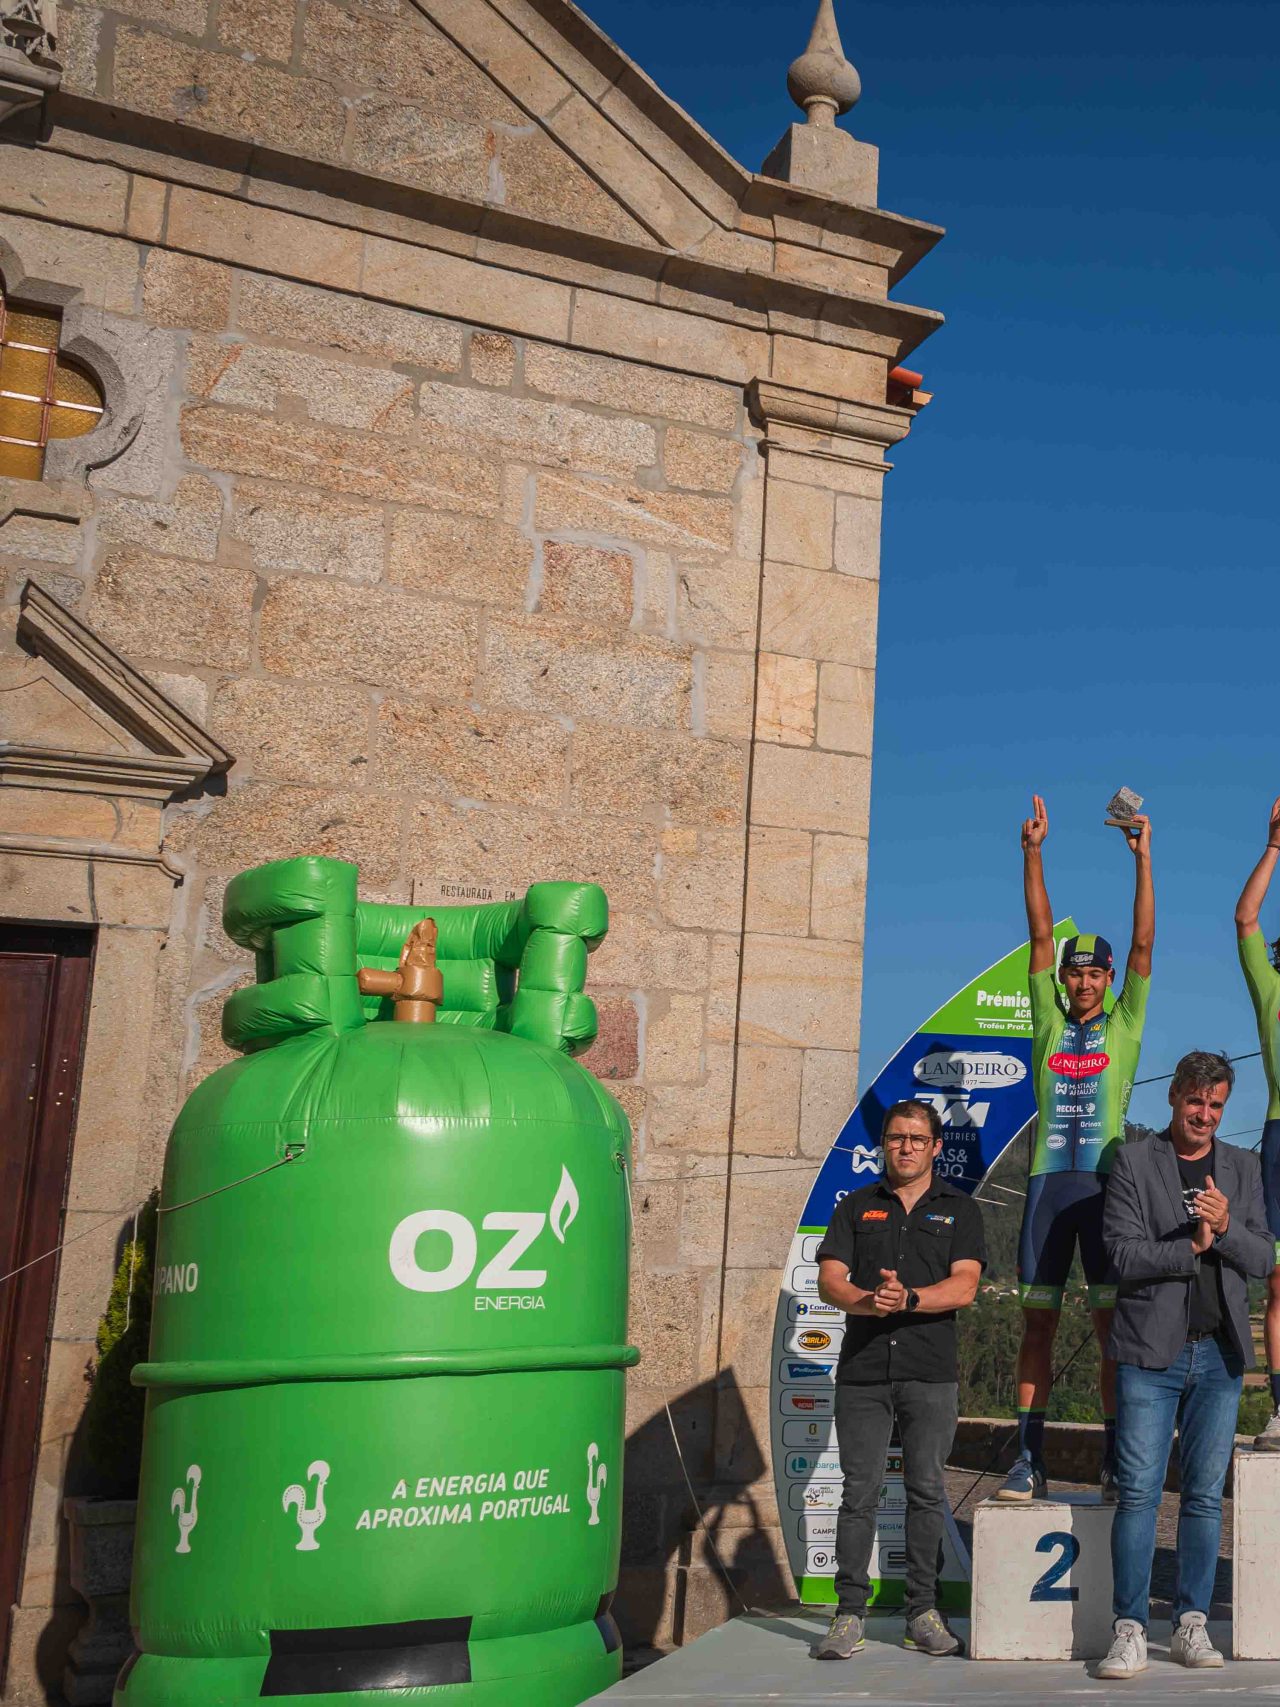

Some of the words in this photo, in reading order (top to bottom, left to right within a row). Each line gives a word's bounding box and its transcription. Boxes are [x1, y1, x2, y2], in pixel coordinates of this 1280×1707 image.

[441, 884, 493, 901] RESTAURADA
[505, 890, 516, 901] EM
[976, 989, 1031, 1007] Prémio
[978, 1021, 1004, 1030] Troféu
[1007, 1023, 1026, 1031] Prof.
[922, 1061, 1019, 1076] LANDEIRO
[1051, 1056, 1106, 1070] LANDEIRO
[899, 1093, 990, 1128] TM
[941, 1132, 977, 1141] STRIES
[389, 1209, 547, 1292] OZ
[155, 1262, 199, 1294] PANO
[475, 1296, 546, 1311] ENERGIA
[809, 1303, 841, 1311] Confor
[809, 1460, 841, 1471] Libarge
[392, 1479, 407, 1500] A
[415, 1472, 506, 1498] ENERGIA
[513, 1468, 550, 1491] QUE
[355, 1503, 472, 1531] APROXIMA
[479, 1494, 571, 1522] PORTUGAL
[812, 1527, 837, 1535] CAMPE
[1029, 1531, 1081, 1602] 2
